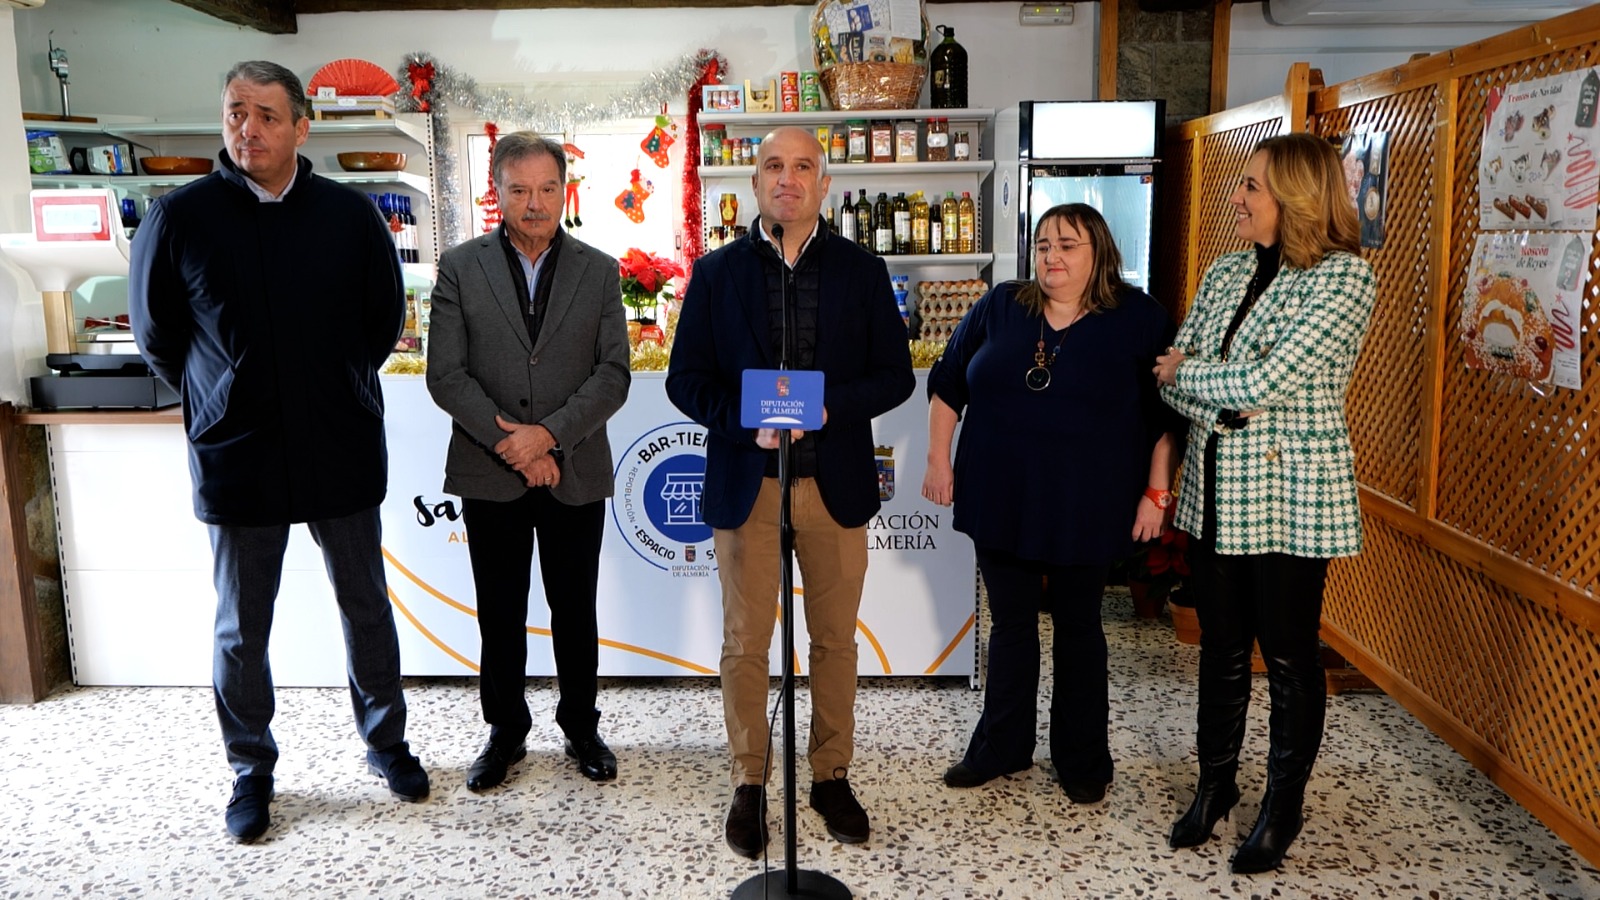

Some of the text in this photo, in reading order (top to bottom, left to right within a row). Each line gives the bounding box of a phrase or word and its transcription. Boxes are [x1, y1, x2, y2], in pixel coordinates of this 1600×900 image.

[1520, 244, 1549, 256] Roscón
[1526, 256, 1548, 271] Reyes
[760, 400, 804, 408] DIPUTACIÓN
[624, 466, 639, 523] REPOBLACIÓN
[635, 528, 676, 560] ESPACIO
